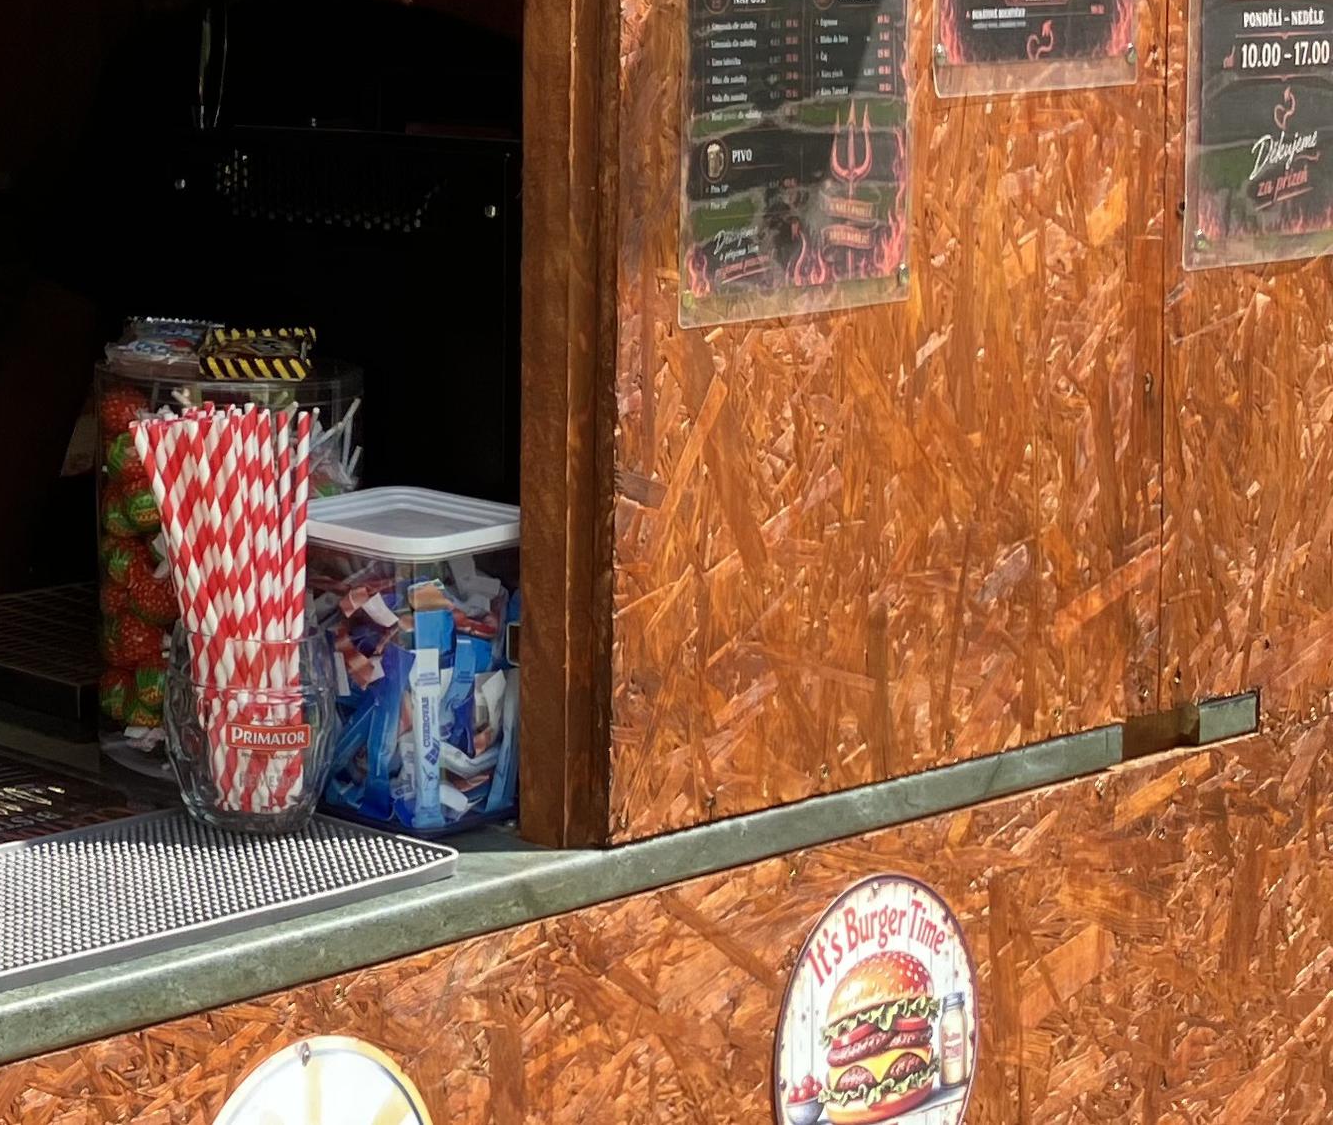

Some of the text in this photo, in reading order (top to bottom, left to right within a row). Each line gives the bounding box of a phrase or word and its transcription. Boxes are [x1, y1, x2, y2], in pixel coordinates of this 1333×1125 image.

[1243, 7, 1282, 28] PONDĚLÍ
[1291, 7, 1325, 27] NEDĚLE
[1241, 42, 1281, 68] 10.00
[1294, 40, 1330, 67] 17.00
[732, 149, 753, 164] PIVO
[1249, 131, 1318, 181] Děkujeme
[1257, 177, 1274, 197] za
[230, 725, 305, 746] PRIMATOR
[804, 899, 948, 988] It's Burger Time
